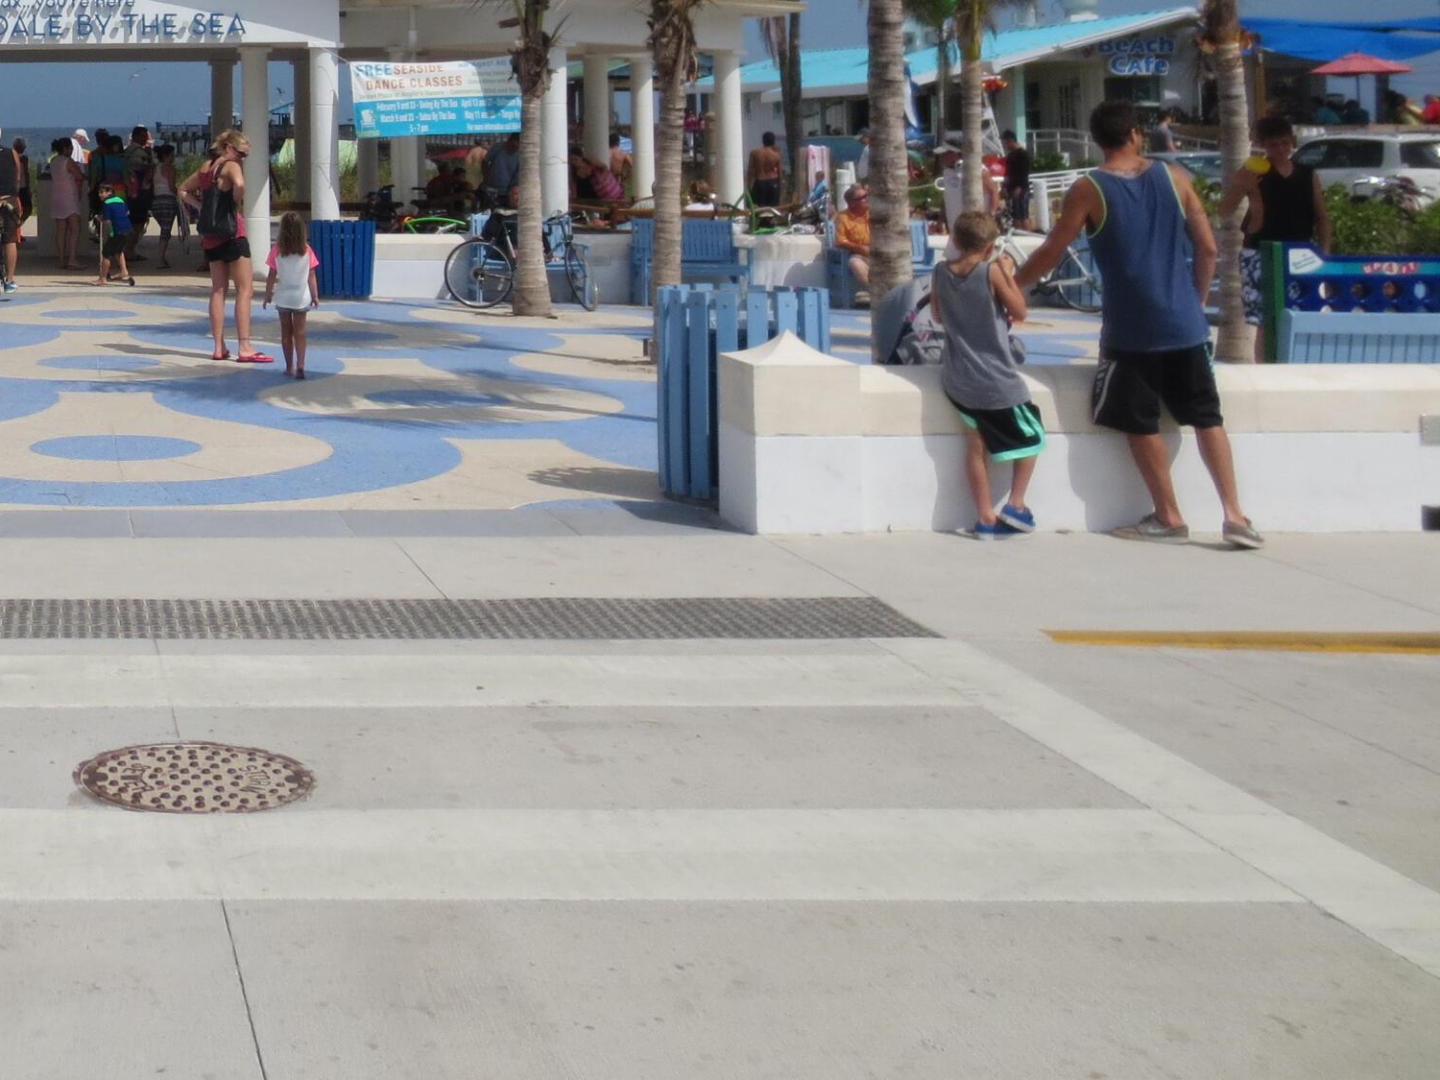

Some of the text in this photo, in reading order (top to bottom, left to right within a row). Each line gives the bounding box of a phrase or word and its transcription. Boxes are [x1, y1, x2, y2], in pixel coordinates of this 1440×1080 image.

[76, 14, 111, 37] BY
[123, 13, 177, 36] THE
[192, 13, 247, 36] SEA
[393, 64, 444, 76] SEASIDE
[366, 78, 405, 91] DANCE
[410, 75, 463, 89] CLASSES
